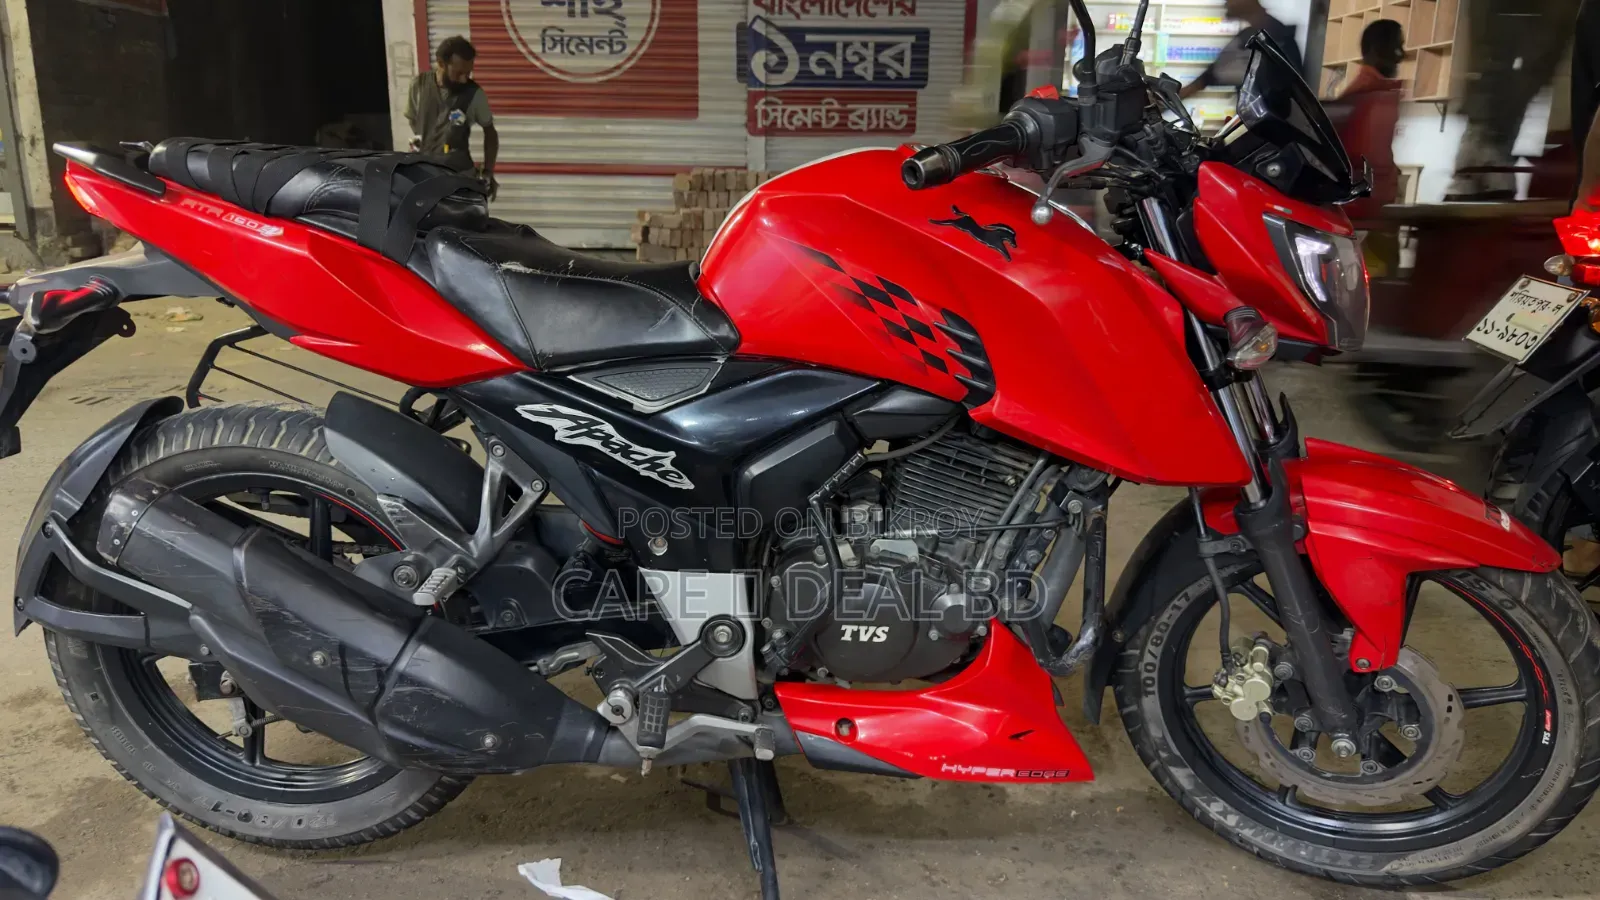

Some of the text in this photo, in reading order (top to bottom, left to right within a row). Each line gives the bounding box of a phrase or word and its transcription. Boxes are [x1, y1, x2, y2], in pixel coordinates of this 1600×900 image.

[540, 26, 628, 56] সিমেন্ট
[751, 16, 916, 86] ১ নম্বর
[754, 96, 909, 131] সিমেন্ট ব্র্যান্ড
[517, 405, 693, 488] Apache
[841, 624, 890, 643] TVS
[1142, 591, 1191, 698] 100/80-17
[941, 763, 1016, 777] HYPER
